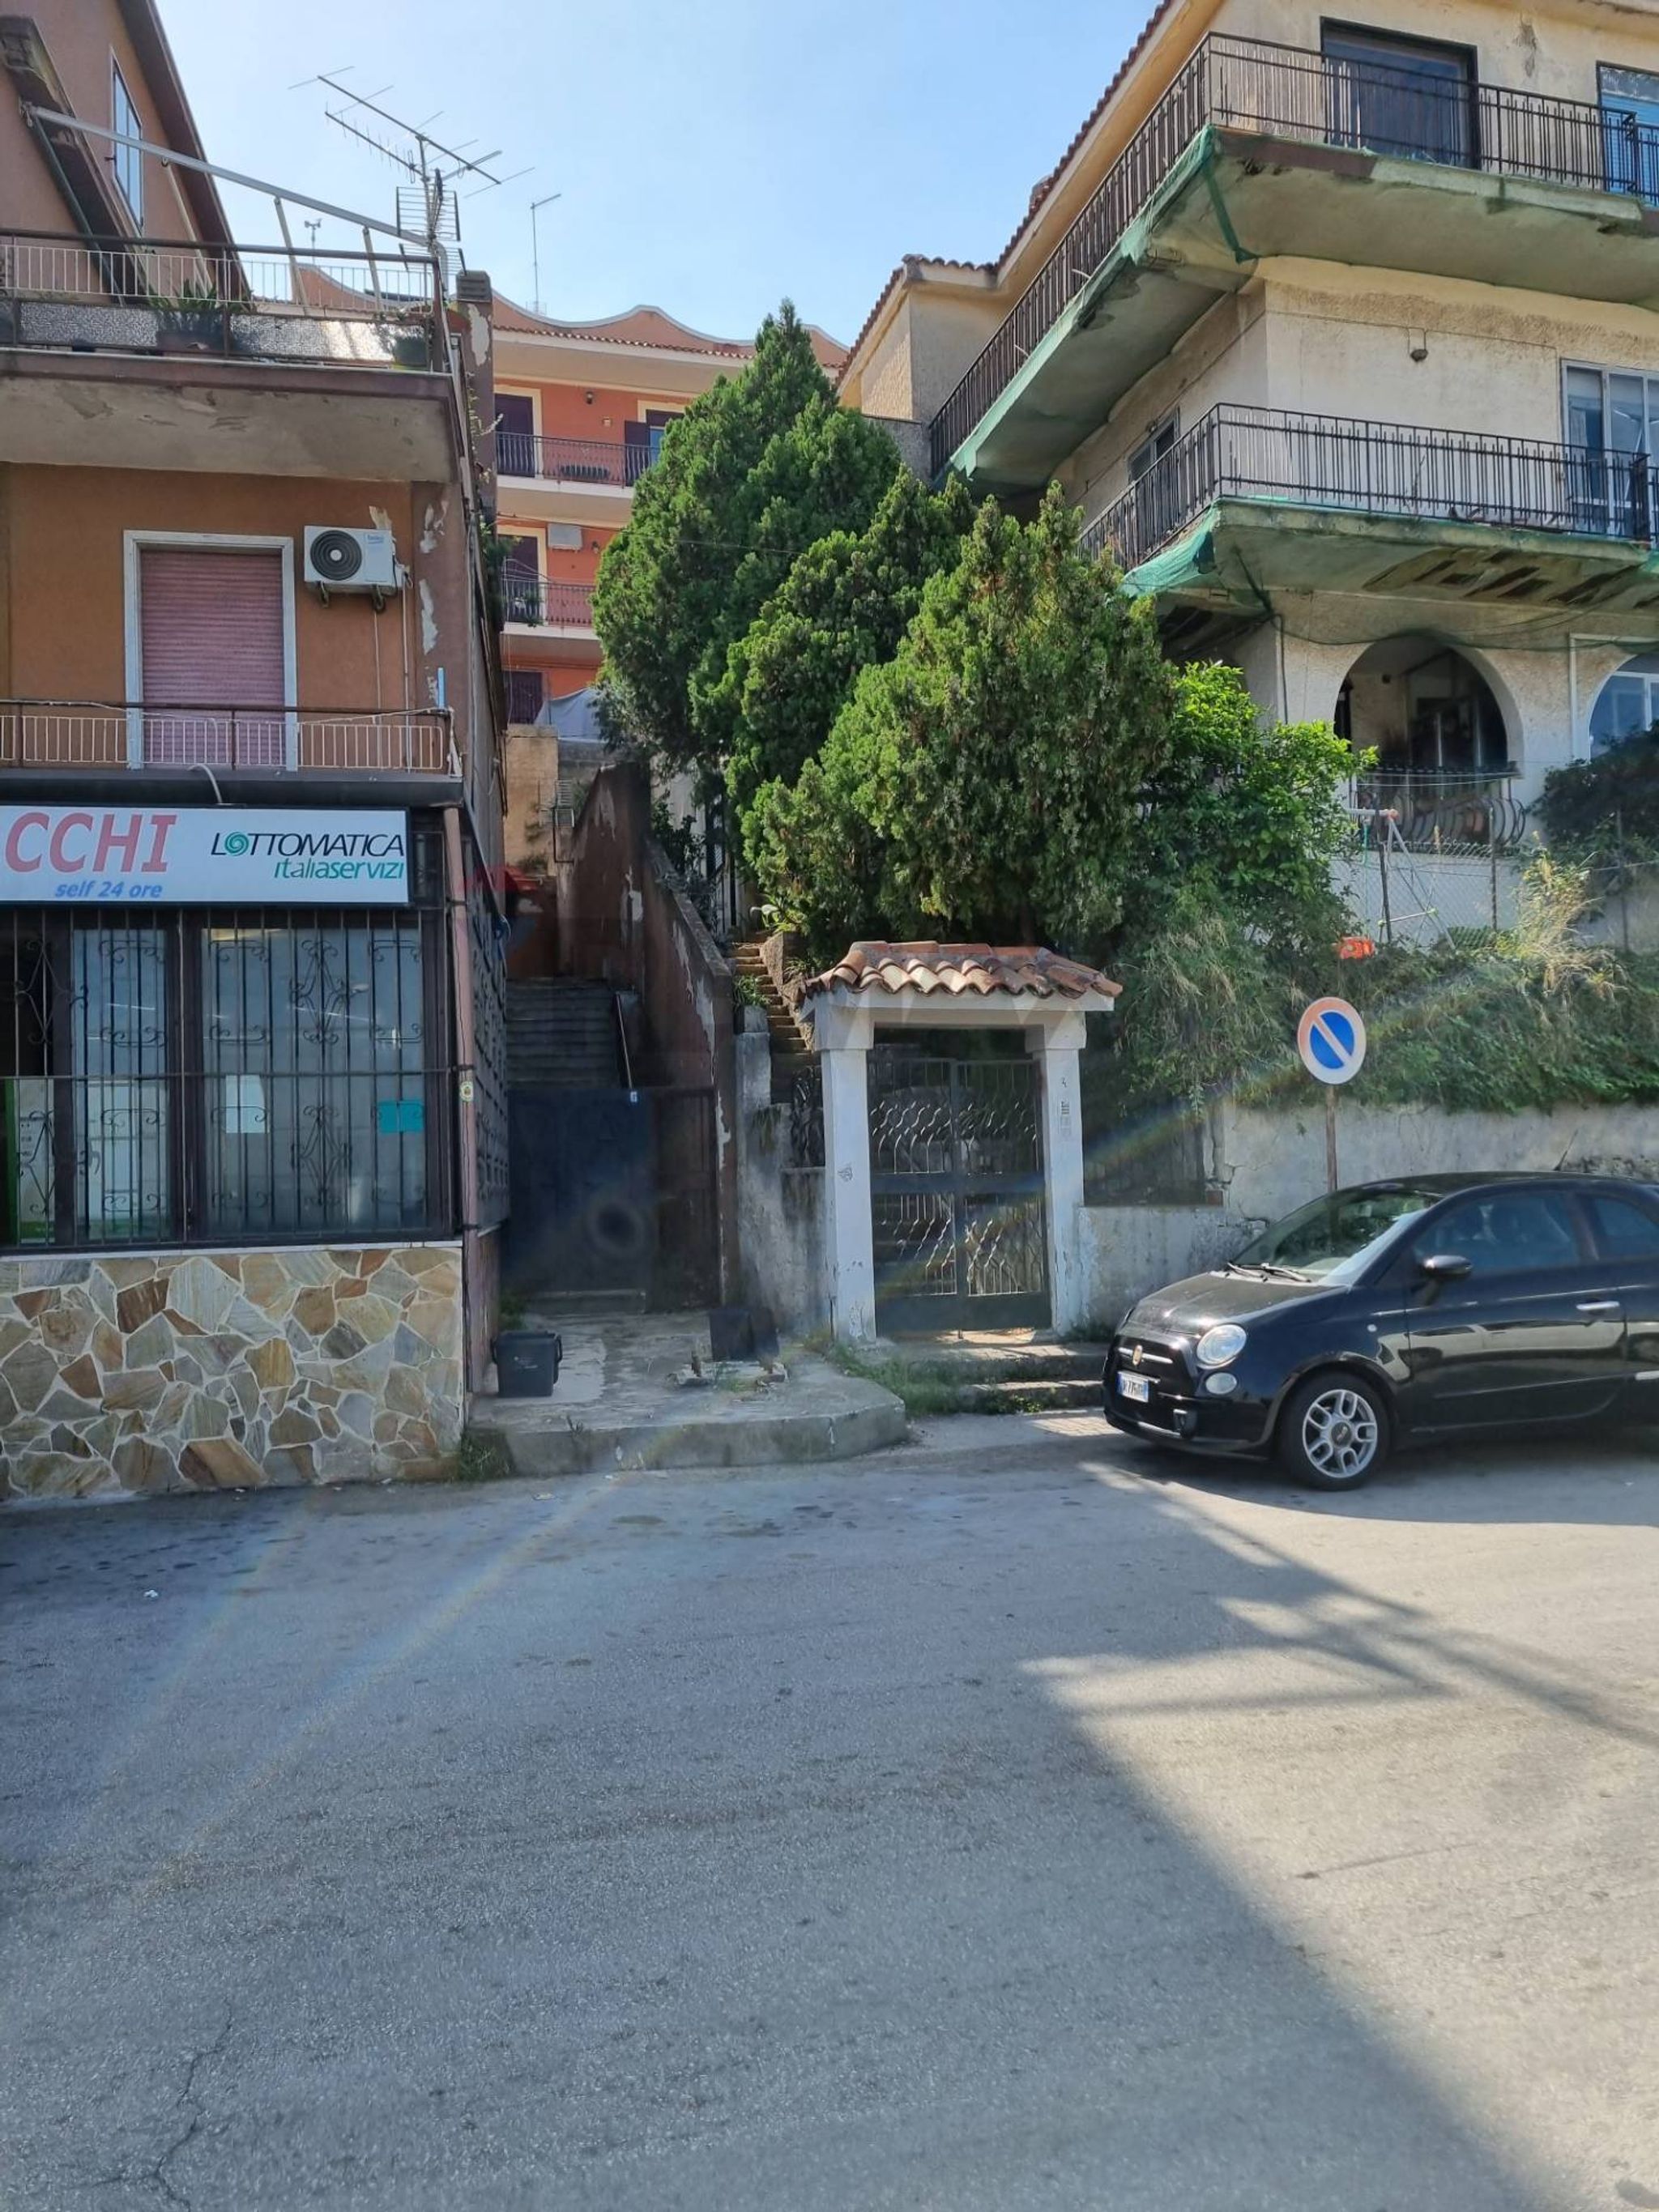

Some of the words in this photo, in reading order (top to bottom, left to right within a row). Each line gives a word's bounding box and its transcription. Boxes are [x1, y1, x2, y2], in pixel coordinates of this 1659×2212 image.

[6, 812, 177, 873] CCHI
[211, 832, 404, 857] LOTTOMATICA
[55, 880, 96, 897] self
[97, 881, 125, 897] 24
[129, 884, 162, 897] ore
